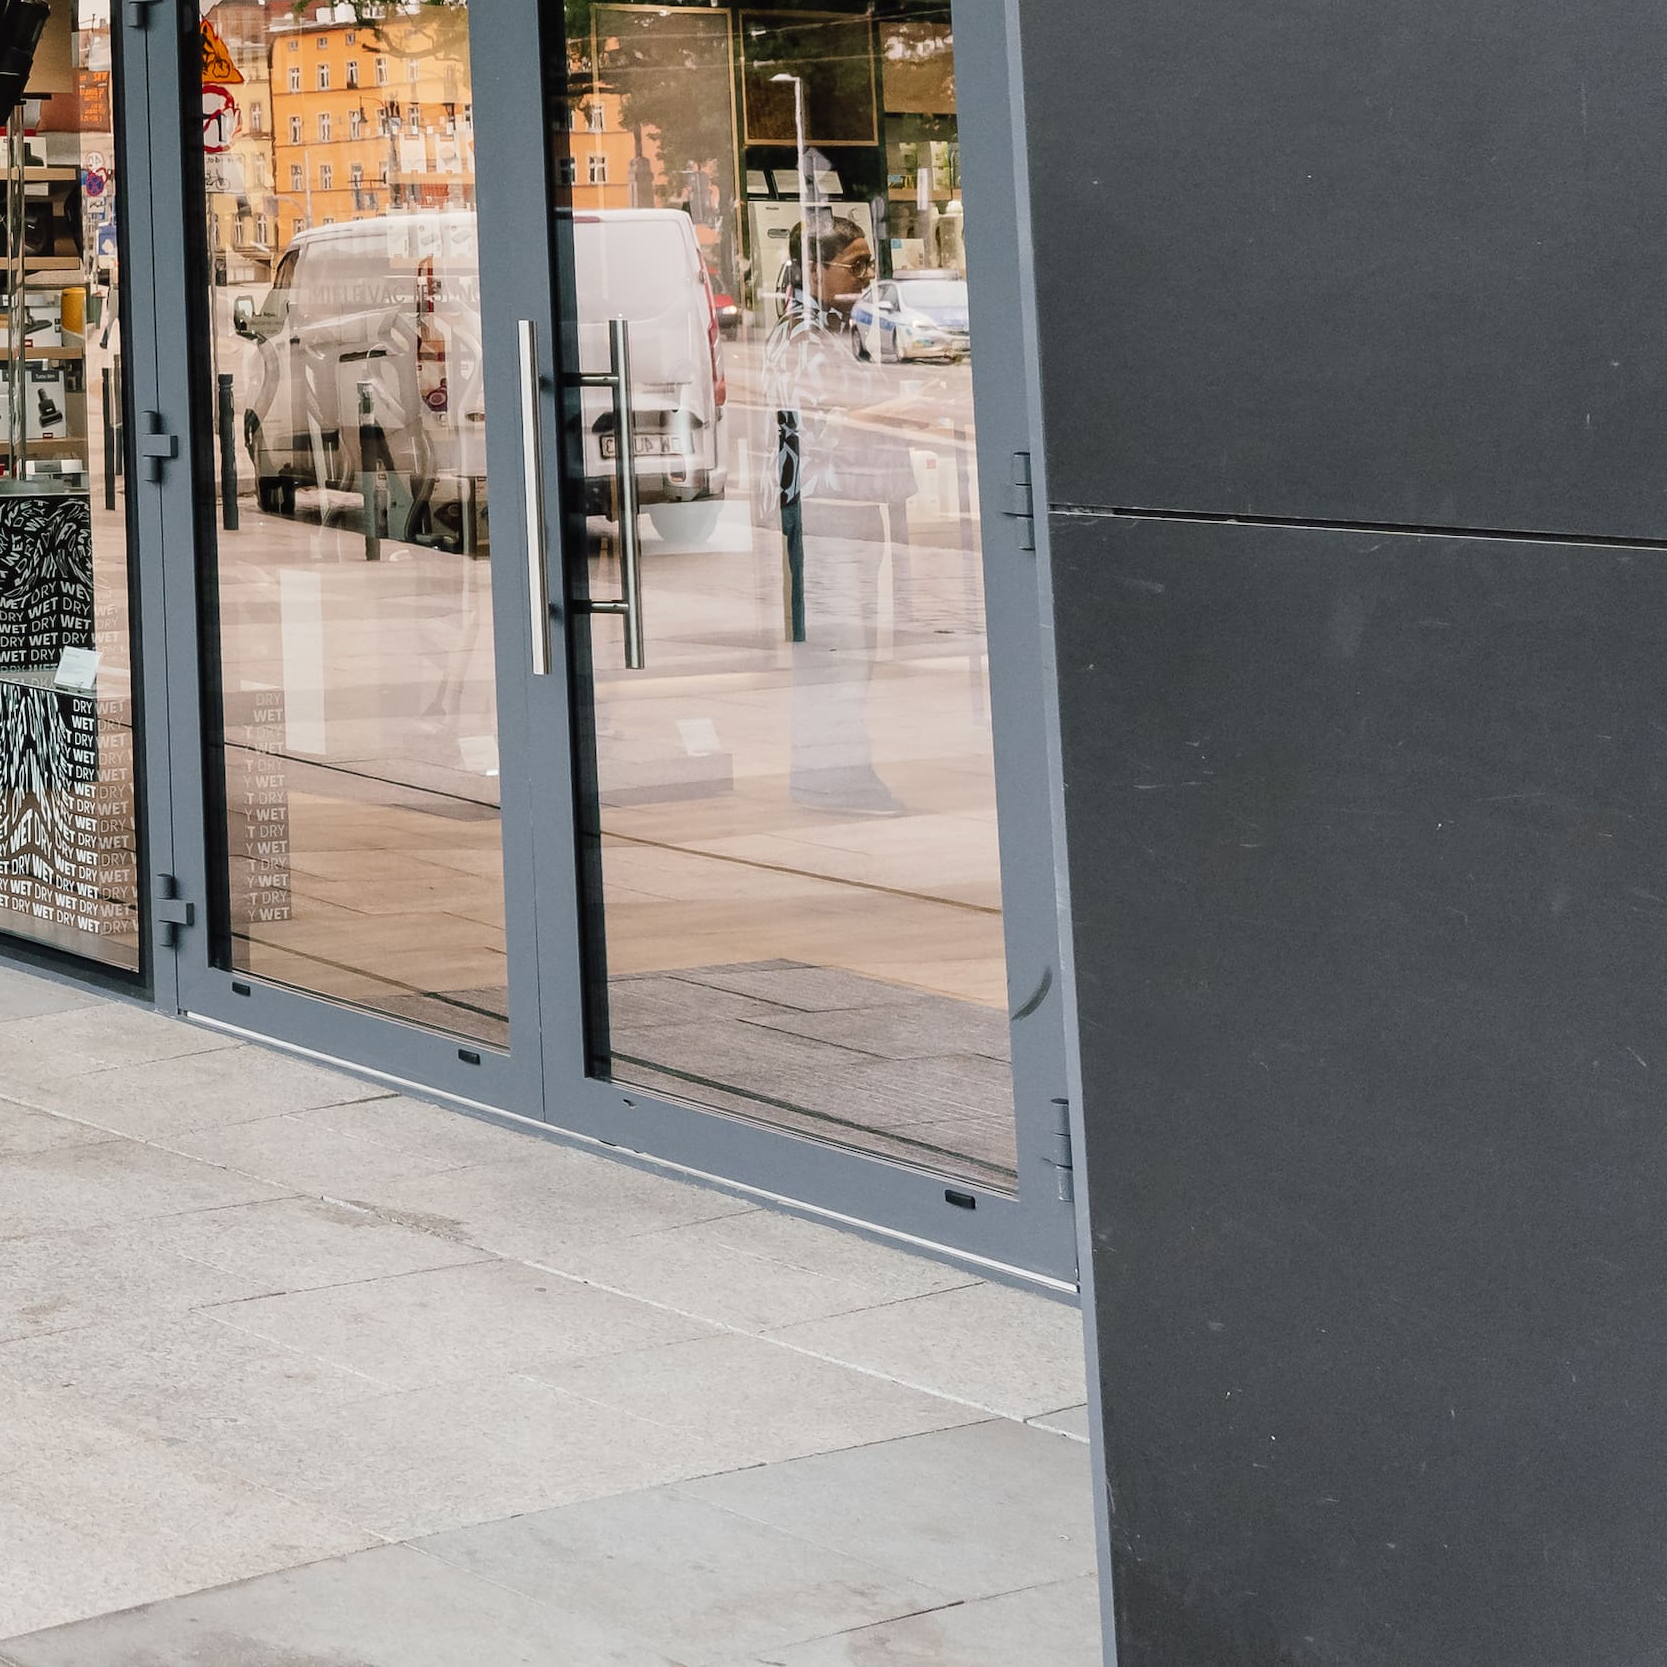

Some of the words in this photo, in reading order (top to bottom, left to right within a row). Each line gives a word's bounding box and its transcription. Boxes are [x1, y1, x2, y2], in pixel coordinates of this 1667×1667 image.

[0, 611, 23, 622] DRY
[28, 597, 58, 619] WET
[63, 597, 90, 616] DRY
[32, 615, 57, 632] DRY
[60, 614, 91, 630] WET
[1, 637, 25, 647] DRY
[29, 633, 58, 646] WET
[62, 633, 87, 644] DRY
[31, 649, 55, 661] DRY
[73, 699, 93, 714] DRY
[72, 715, 94, 731] WET
[75, 733, 93, 748] DRY
[73, 749, 95, 764] WET
[76, 767, 94, 782] DRY
[74, 782, 96, 798] WET
[77, 799, 96, 815] DRY
[75, 812, 97, 832] WET
[78, 833, 97, 848] DRY
[76, 849, 98, 866] WET
[12, 853, 31, 875] DRY
[32, 854, 54, 885] WET
[56, 875, 75, 892] DRY
[77, 883, 99, 900] WET
[79, 866, 97, 882] DRY
[10, 879, 32, 896] WET
[35, 885, 52, 902] DRY
[55, 892, 77, 910] WET
[80, 899, 99, 916] DRY
[12, 897, 30, 913] DRY
[32, 903, 54, 920] WET
[57, 909, 75, 926] DRY
[78, 916, 100, 933] WET
